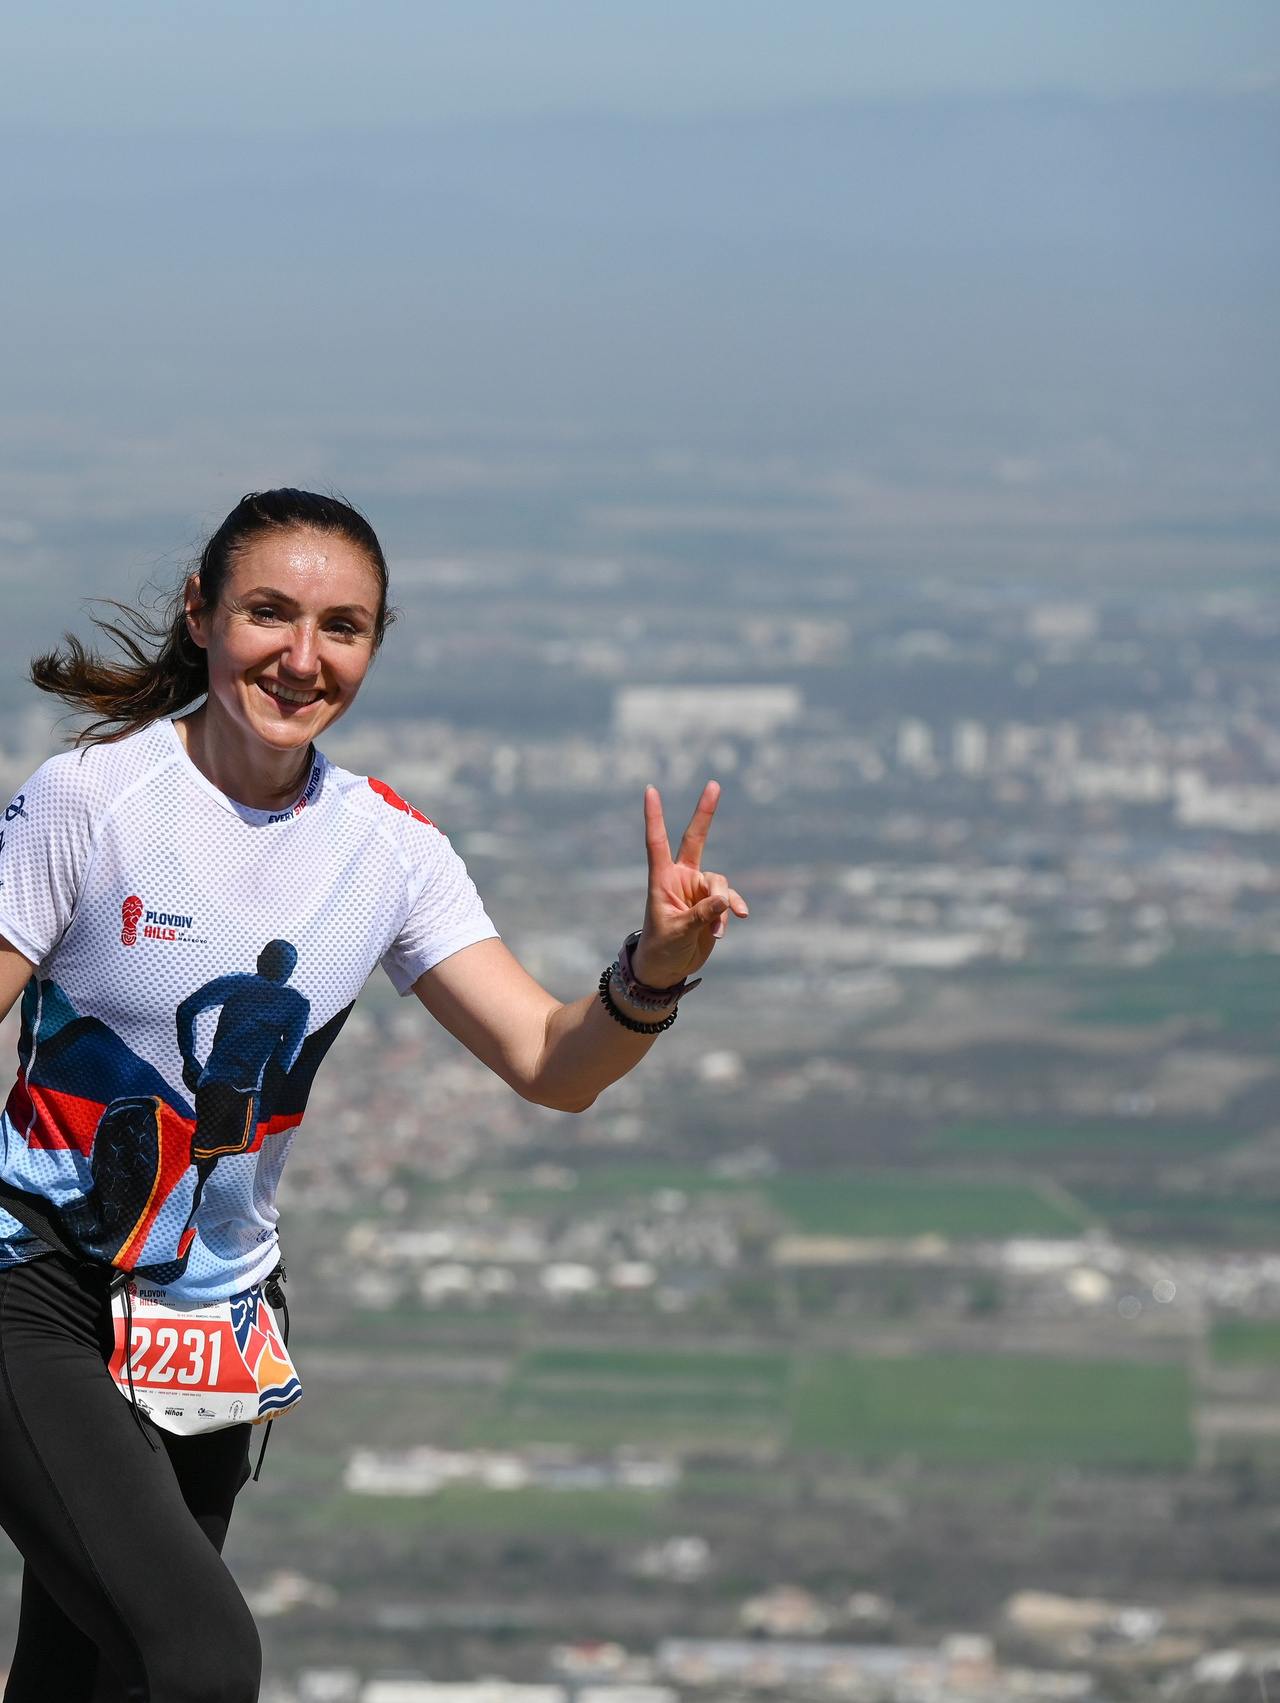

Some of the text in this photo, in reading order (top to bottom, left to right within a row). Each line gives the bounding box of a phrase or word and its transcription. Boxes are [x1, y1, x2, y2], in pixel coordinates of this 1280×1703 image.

[268, 765, 321, 824] EVERY STEP MATTERS
[146, 910, 193, 929] PLOVDIV
[144, 925, 176, 941] HILLS
[139, 1289, 167, 1298] PLOVDIV
[139, 1298, 159, 1307] HILLS
[119, 1326, 222, 1386] 2231
